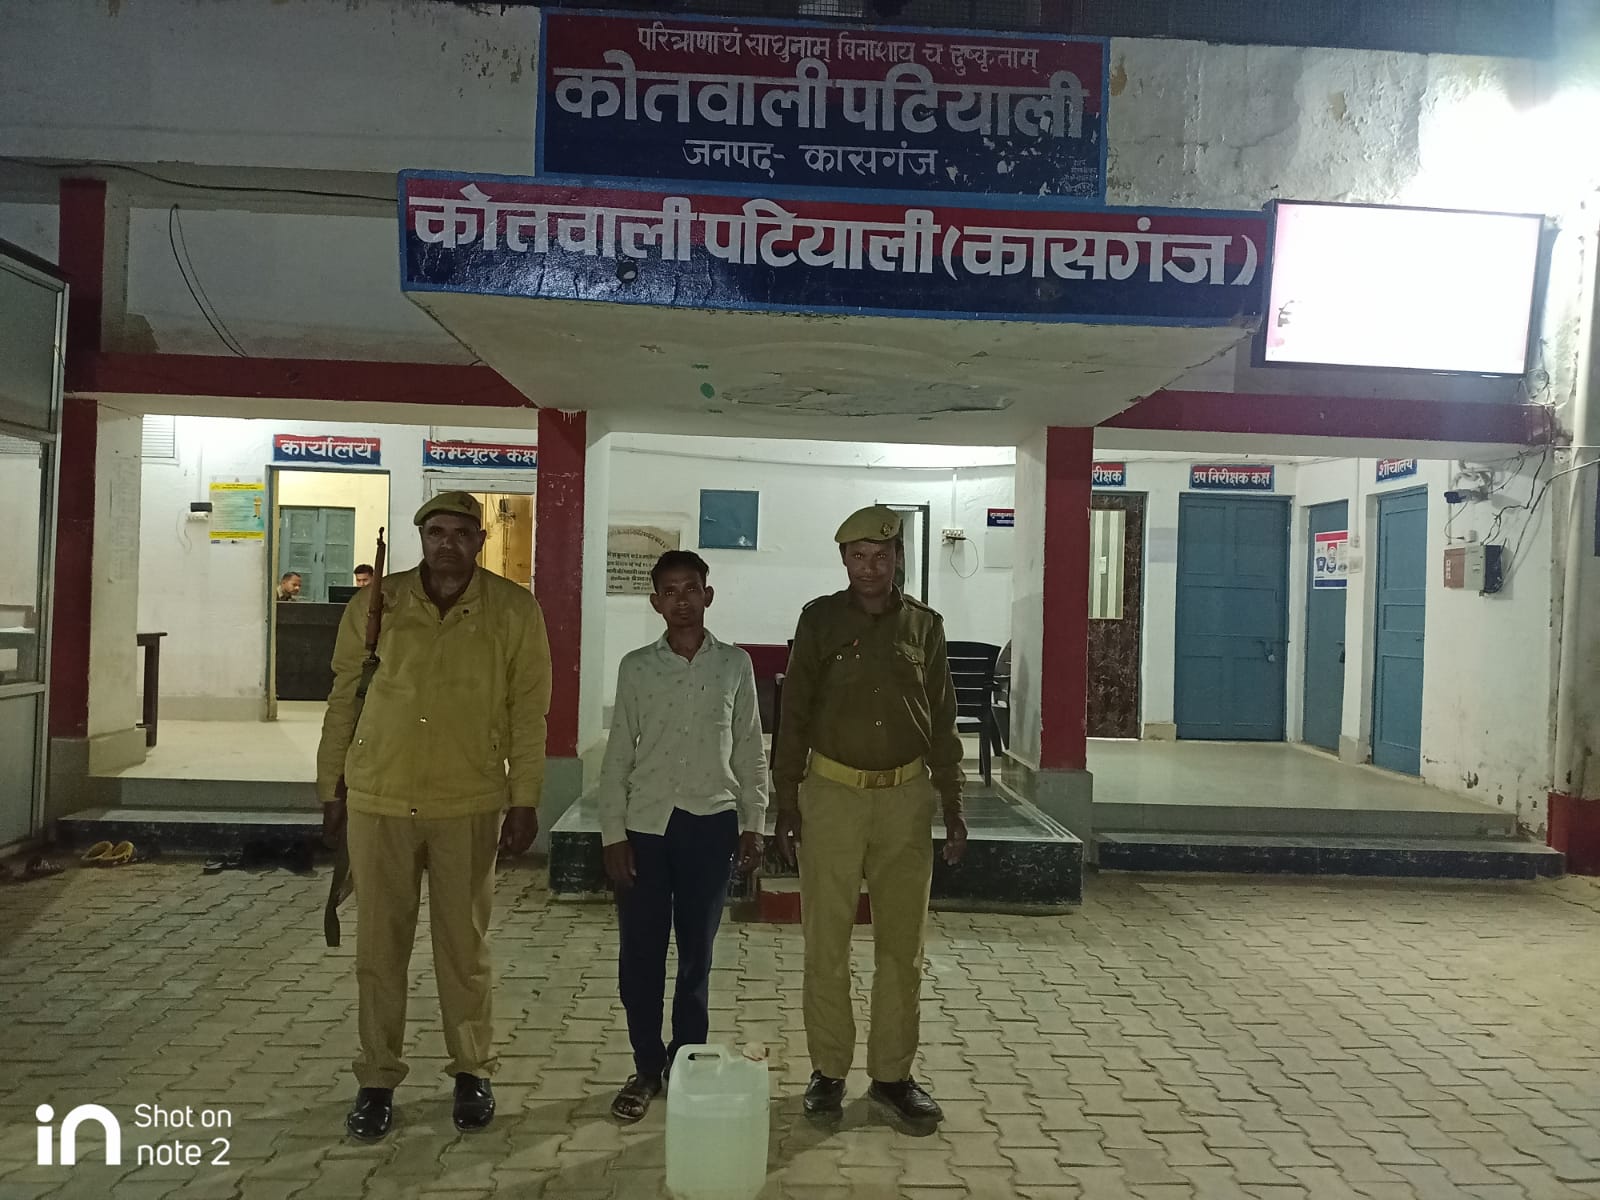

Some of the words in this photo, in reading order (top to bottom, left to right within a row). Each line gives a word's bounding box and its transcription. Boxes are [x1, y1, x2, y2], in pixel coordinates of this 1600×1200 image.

[553, 50, 833, 128] कोतवाली
[834, 62, 1089, 138] पटियाली
[798, 140, 938, 176] कासगंज
[409, 183, 697, 261] कोतवाली
[698, 198, 941, 273] पटियाली
[280, 438, 376, 459] कार्यालय
[1093, 465, 1122, 484] रीक्षक
[1193, 471, 1207, 484] उप
[1207, 468, 1249, 486] निरीक्षक
[1251, 471, 1271, 487] कक्ष
